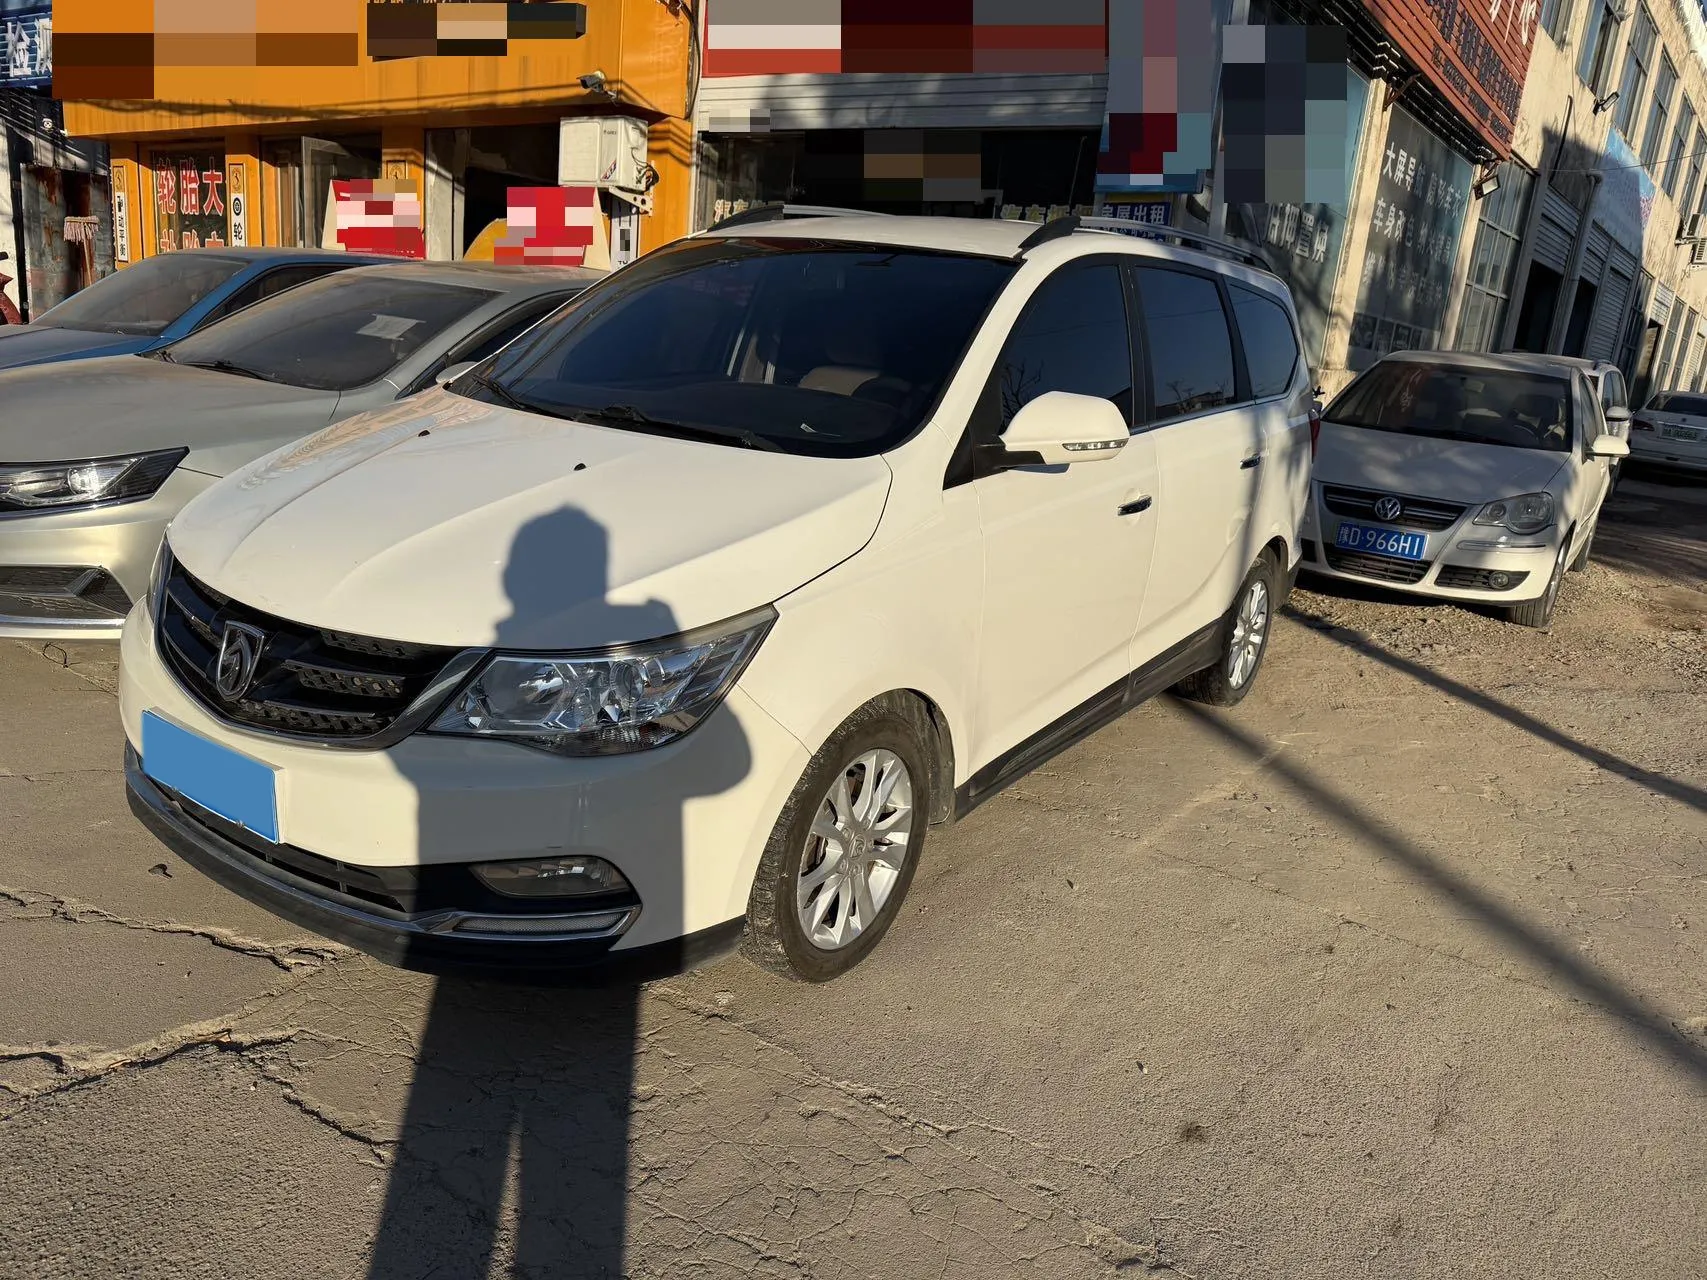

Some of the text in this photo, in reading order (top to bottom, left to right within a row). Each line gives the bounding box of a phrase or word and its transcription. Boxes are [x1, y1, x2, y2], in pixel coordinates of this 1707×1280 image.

[156, 157, 225, 216] 轮胎大
[1102, 204, 1166, 225] 房屋出租
